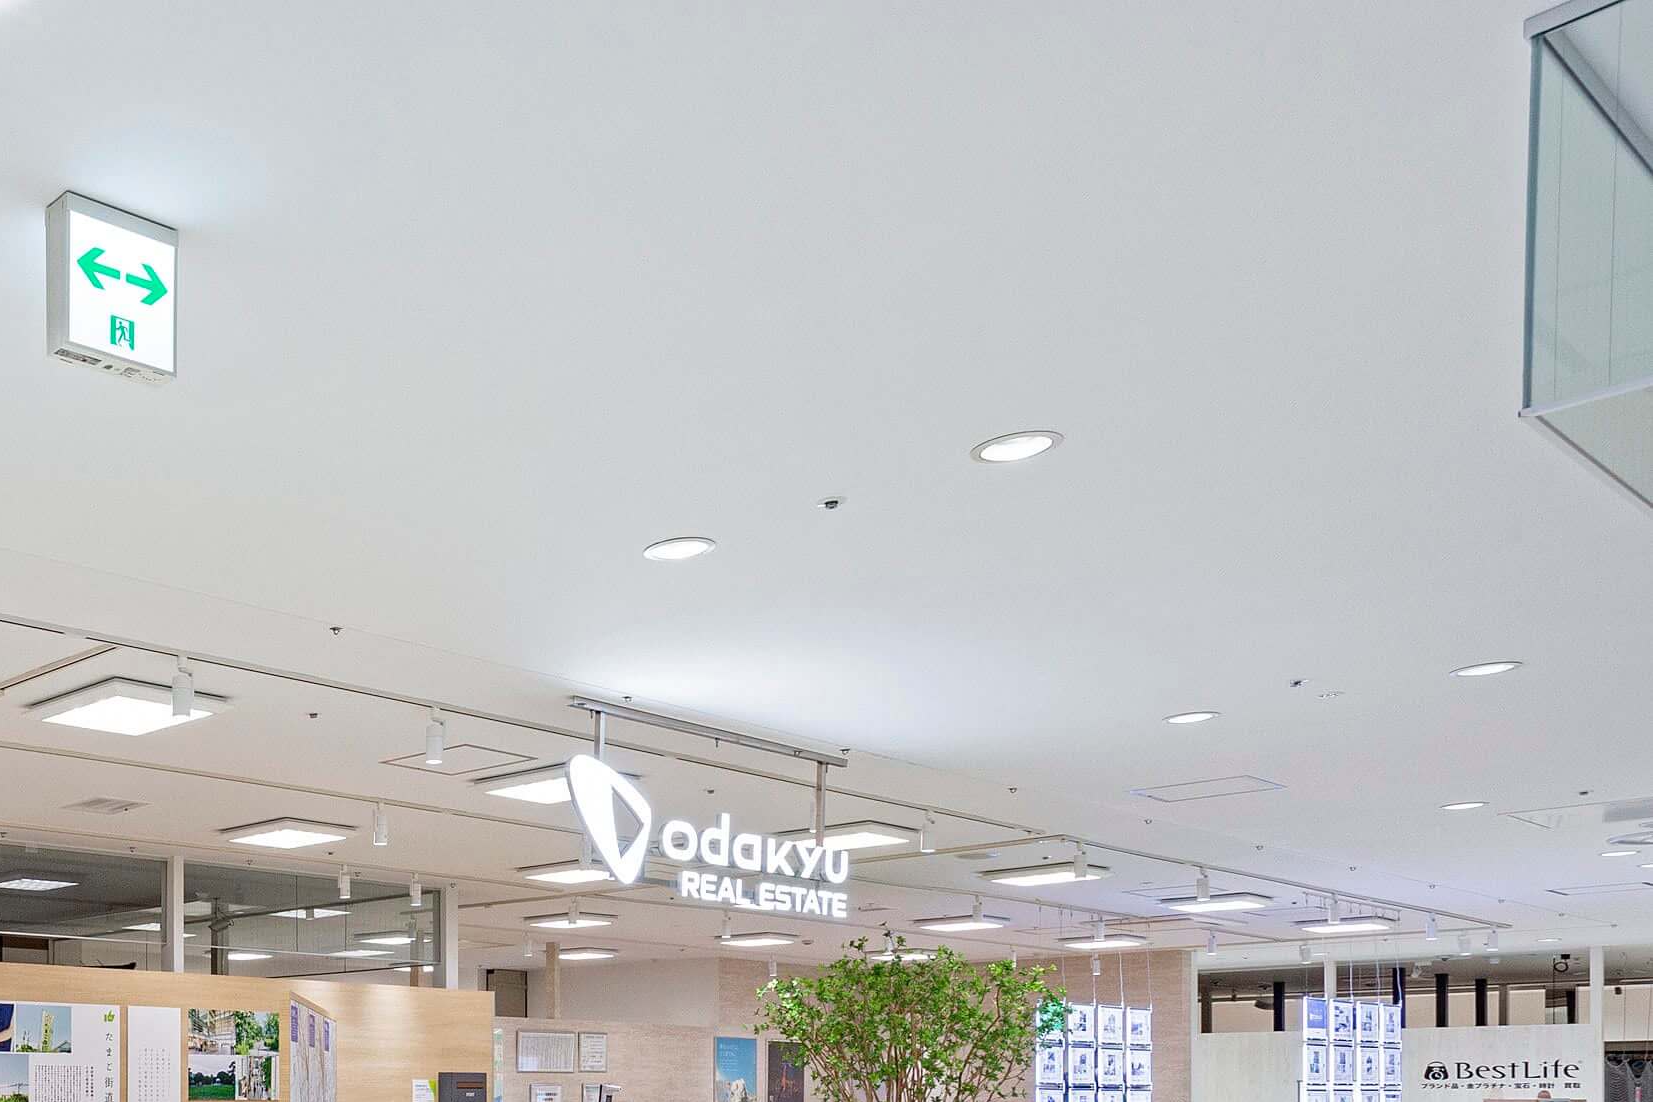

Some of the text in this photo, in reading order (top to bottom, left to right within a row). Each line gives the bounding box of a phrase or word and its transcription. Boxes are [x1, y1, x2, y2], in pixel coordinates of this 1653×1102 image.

[661, 812, 849, 884] odakyu
[680, 870, 848, 918] REAL ESTATE
